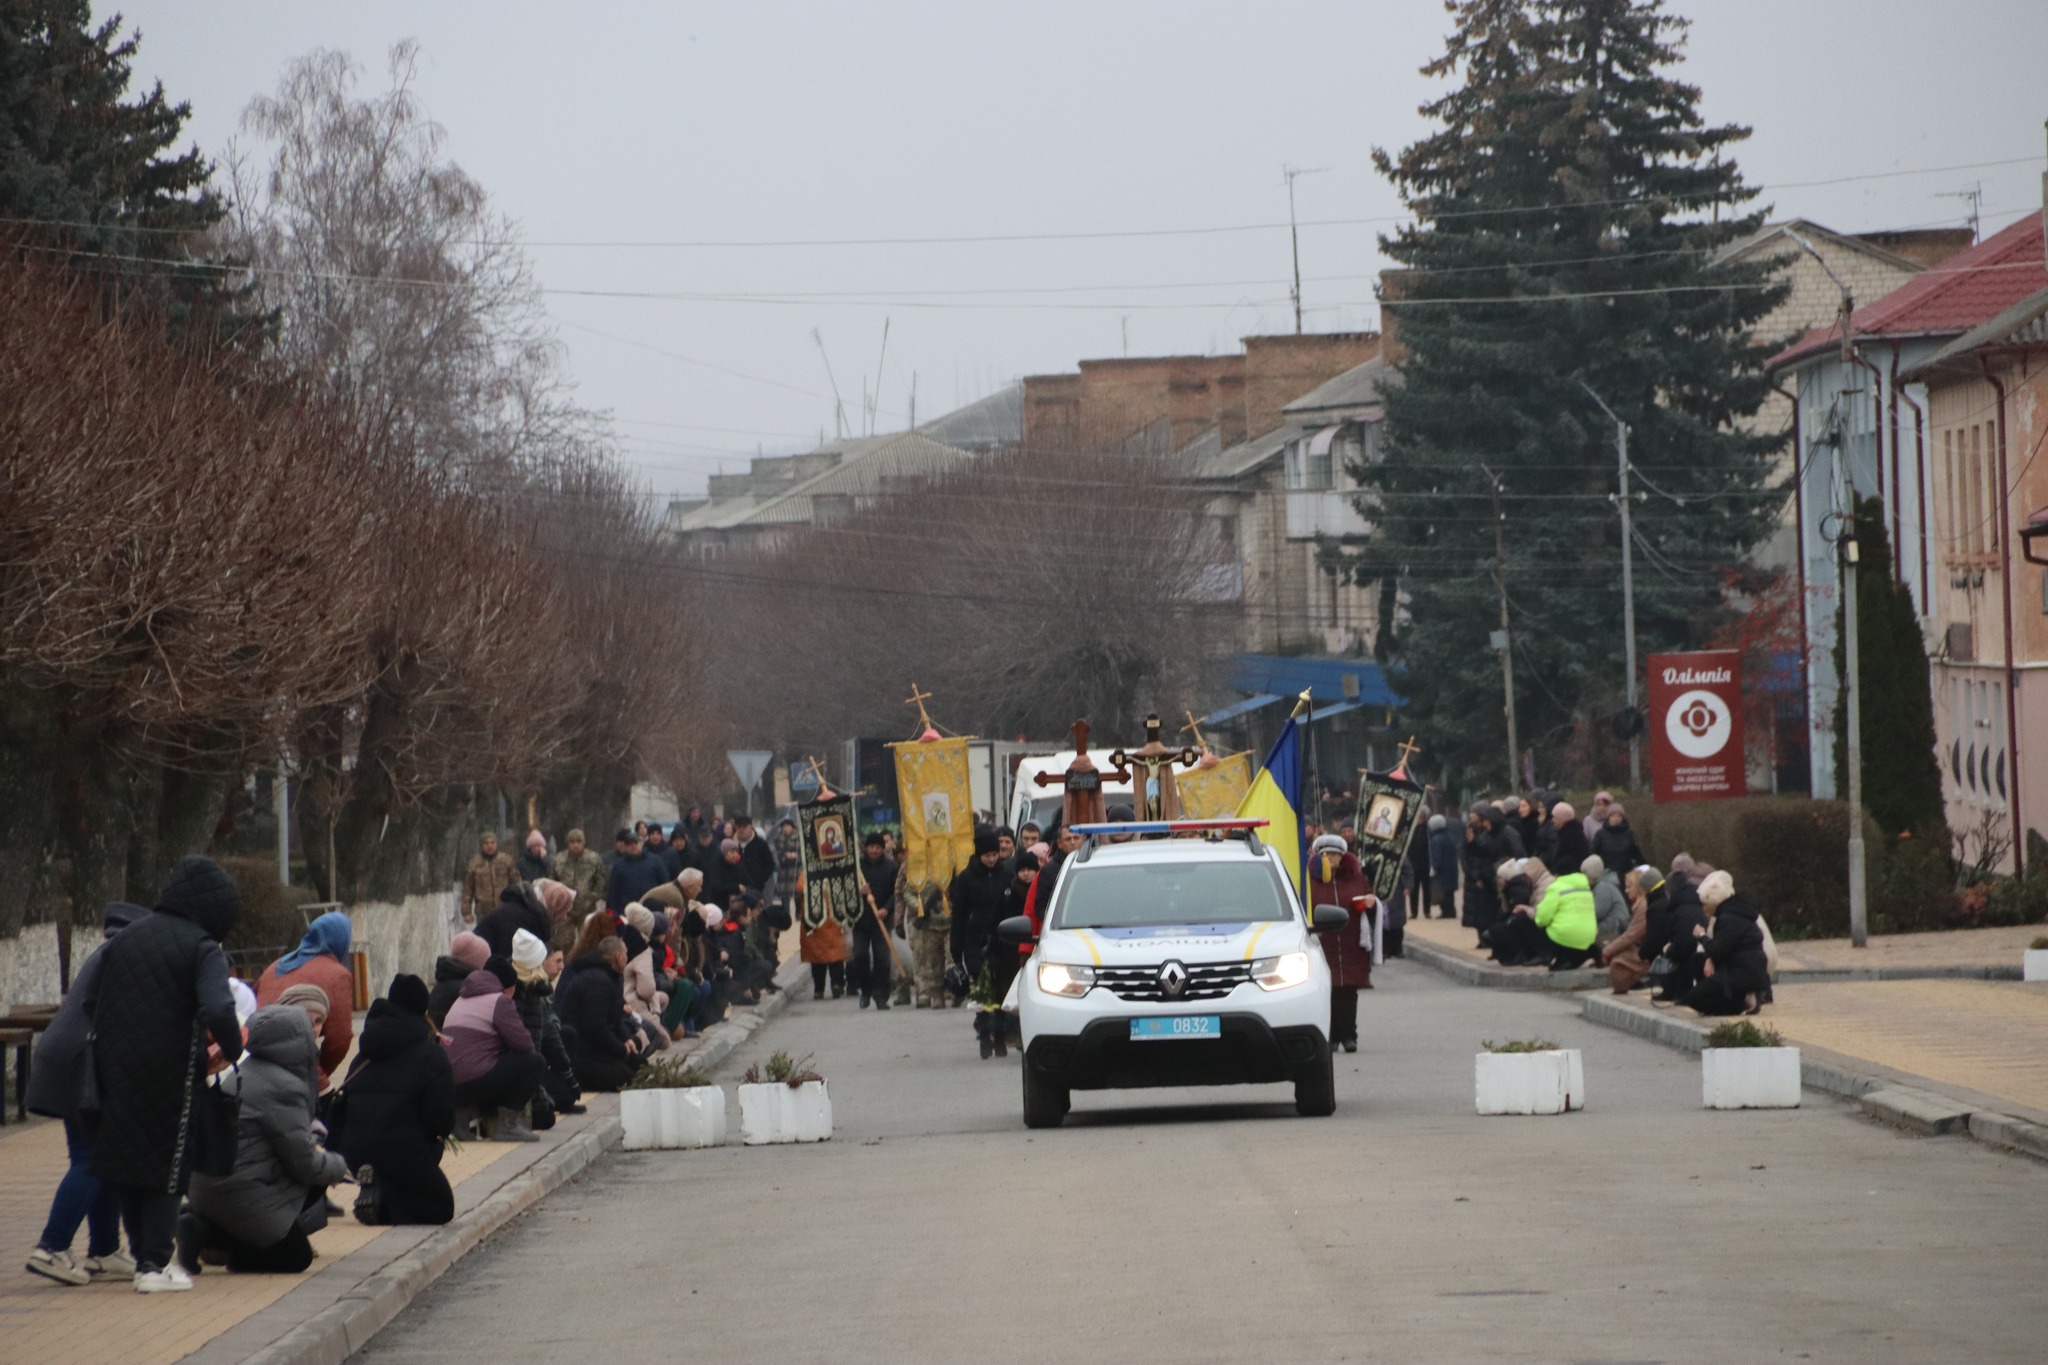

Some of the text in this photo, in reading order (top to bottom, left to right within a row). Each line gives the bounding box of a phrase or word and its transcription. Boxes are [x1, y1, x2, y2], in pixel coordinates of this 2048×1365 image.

[1663, 666, 1732, 685] Олімпія
[1676, 775, 1685, 783] ТА
[1114, 936, 1230, 948] ПОЛІЦІЯ
[1173, 1017, 1209, 1033] 0832
